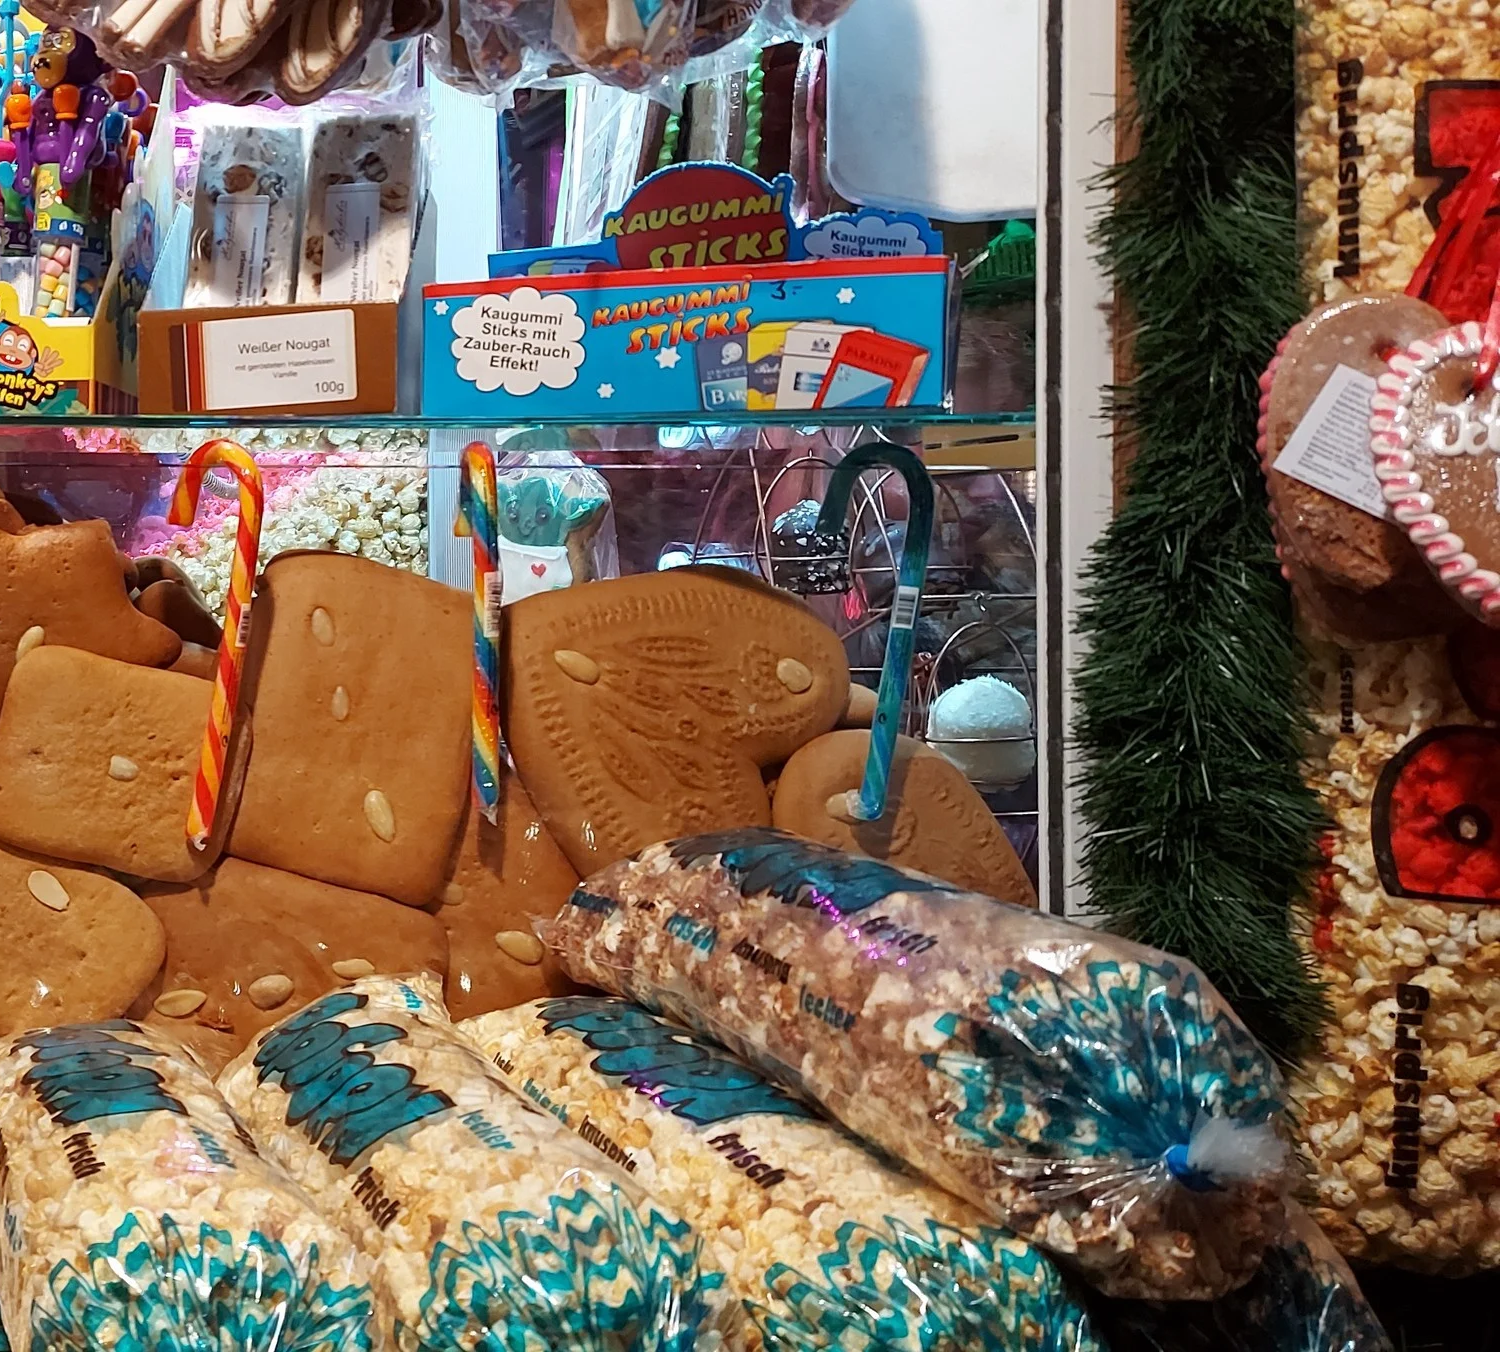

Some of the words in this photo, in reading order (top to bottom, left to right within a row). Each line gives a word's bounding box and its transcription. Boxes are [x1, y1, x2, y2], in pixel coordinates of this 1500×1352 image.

[1333, 58, 1364, 278] knusprig
[830, 230, 907, 249] Kaugummi
[832, 243, 875, 258] Sticks
[481, 306, 563, 326] Kaugummi
[481, 322, 528, 339] Sticks
[532, 327, 557, 341] mit
[238, 341, 281, 355] Weißer
[286, 338, 331, 353] Nougat
[463, 337, 570, 359] Zauber-Rauch
[490, 355, 539, 372] Effekt!
[315, 381, 345, 394] 100g
[800, 984, 856, 1033] lecker
[1382, 983, 1430, 1188] knusprig
[457, 1109, 517, 1150] lecker
[61, 1132, 106, 1180] frisch
[707, 1132, 787, 1190] frisch
[350, 1166, 401, 1231] frisch
